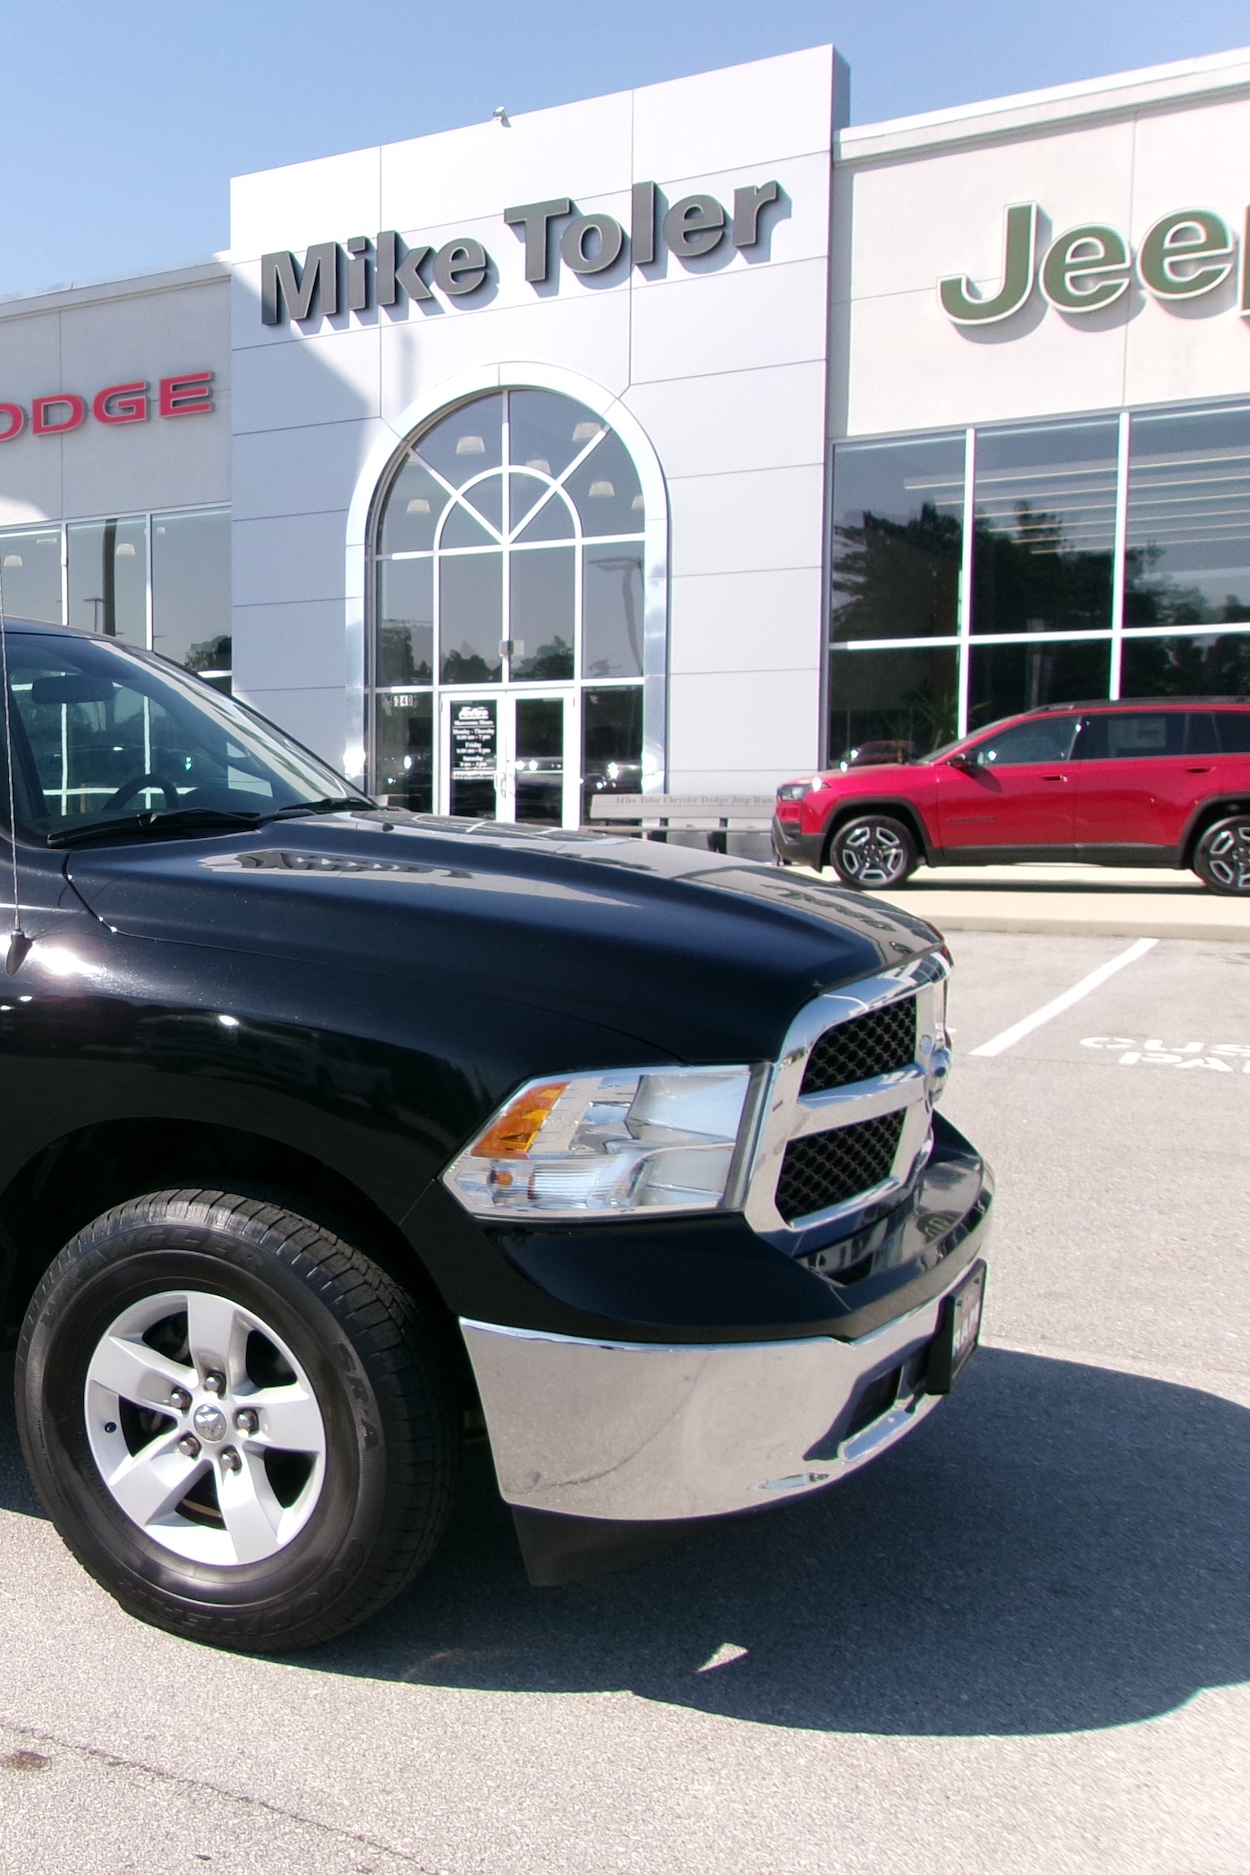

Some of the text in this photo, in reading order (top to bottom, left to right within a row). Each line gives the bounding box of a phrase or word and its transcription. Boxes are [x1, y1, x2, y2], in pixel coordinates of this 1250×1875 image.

[261, 180, 780, 326] Mike Toler
[936, 200, 1250, 326] Jee
